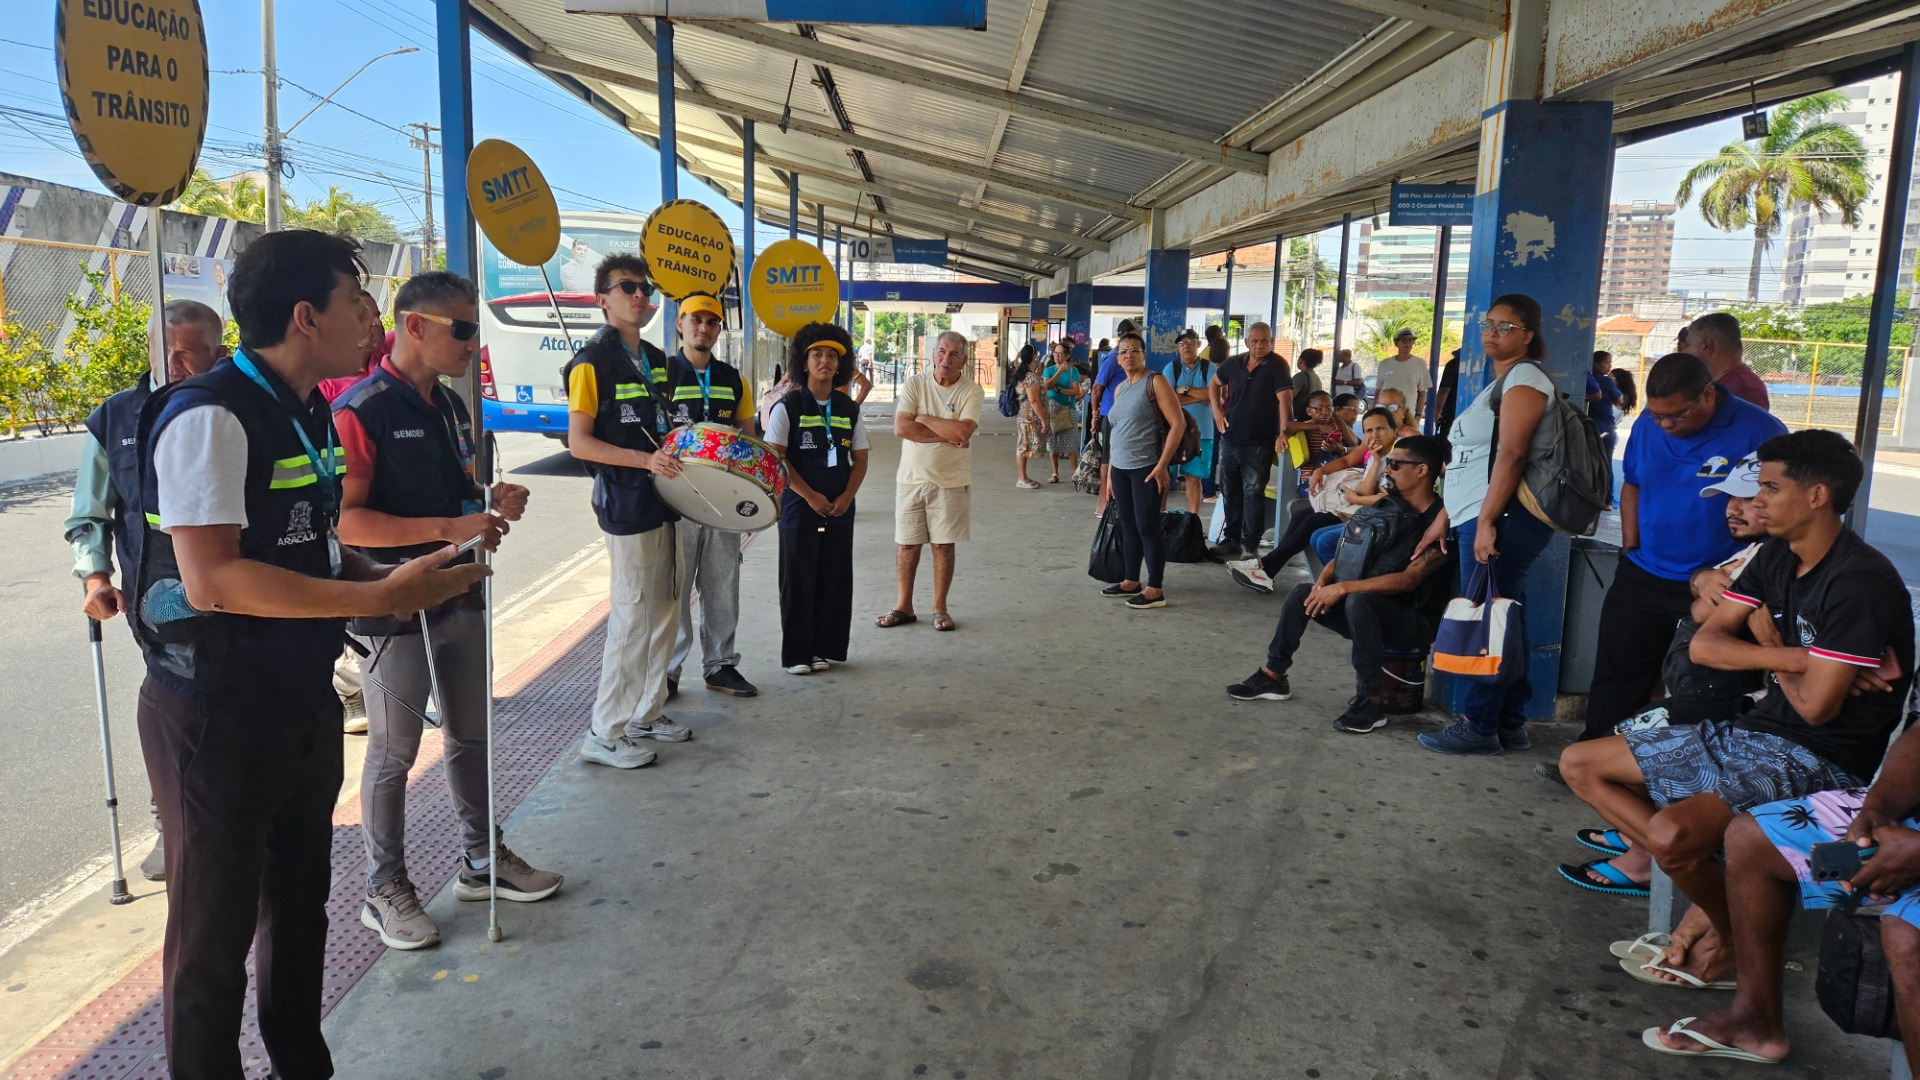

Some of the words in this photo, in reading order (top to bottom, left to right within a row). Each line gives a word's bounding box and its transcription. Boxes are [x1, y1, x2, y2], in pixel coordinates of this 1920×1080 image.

[83, 0, 190, 41] EDUCAÇÃO
[107, 45, 162, 79] PARA
[167, 58, 178, 82] O
[92, 90, 190, 128] TRÂNSITO
[482, 166, 531, 203] SMTT
[609, 240, 639, 249] FANES
[658, 223, 724, 251] EDUCAÇÃO
[849, 240, 870, 258] 10
[667, 243, 699, 260] PARA
[703, 254, 711, 263] O
[656, 257, 717, 282] TRÂNSITO
[766, 265, 822, 285] SMTT
[277, 531, 318, 546] ARACAJU
